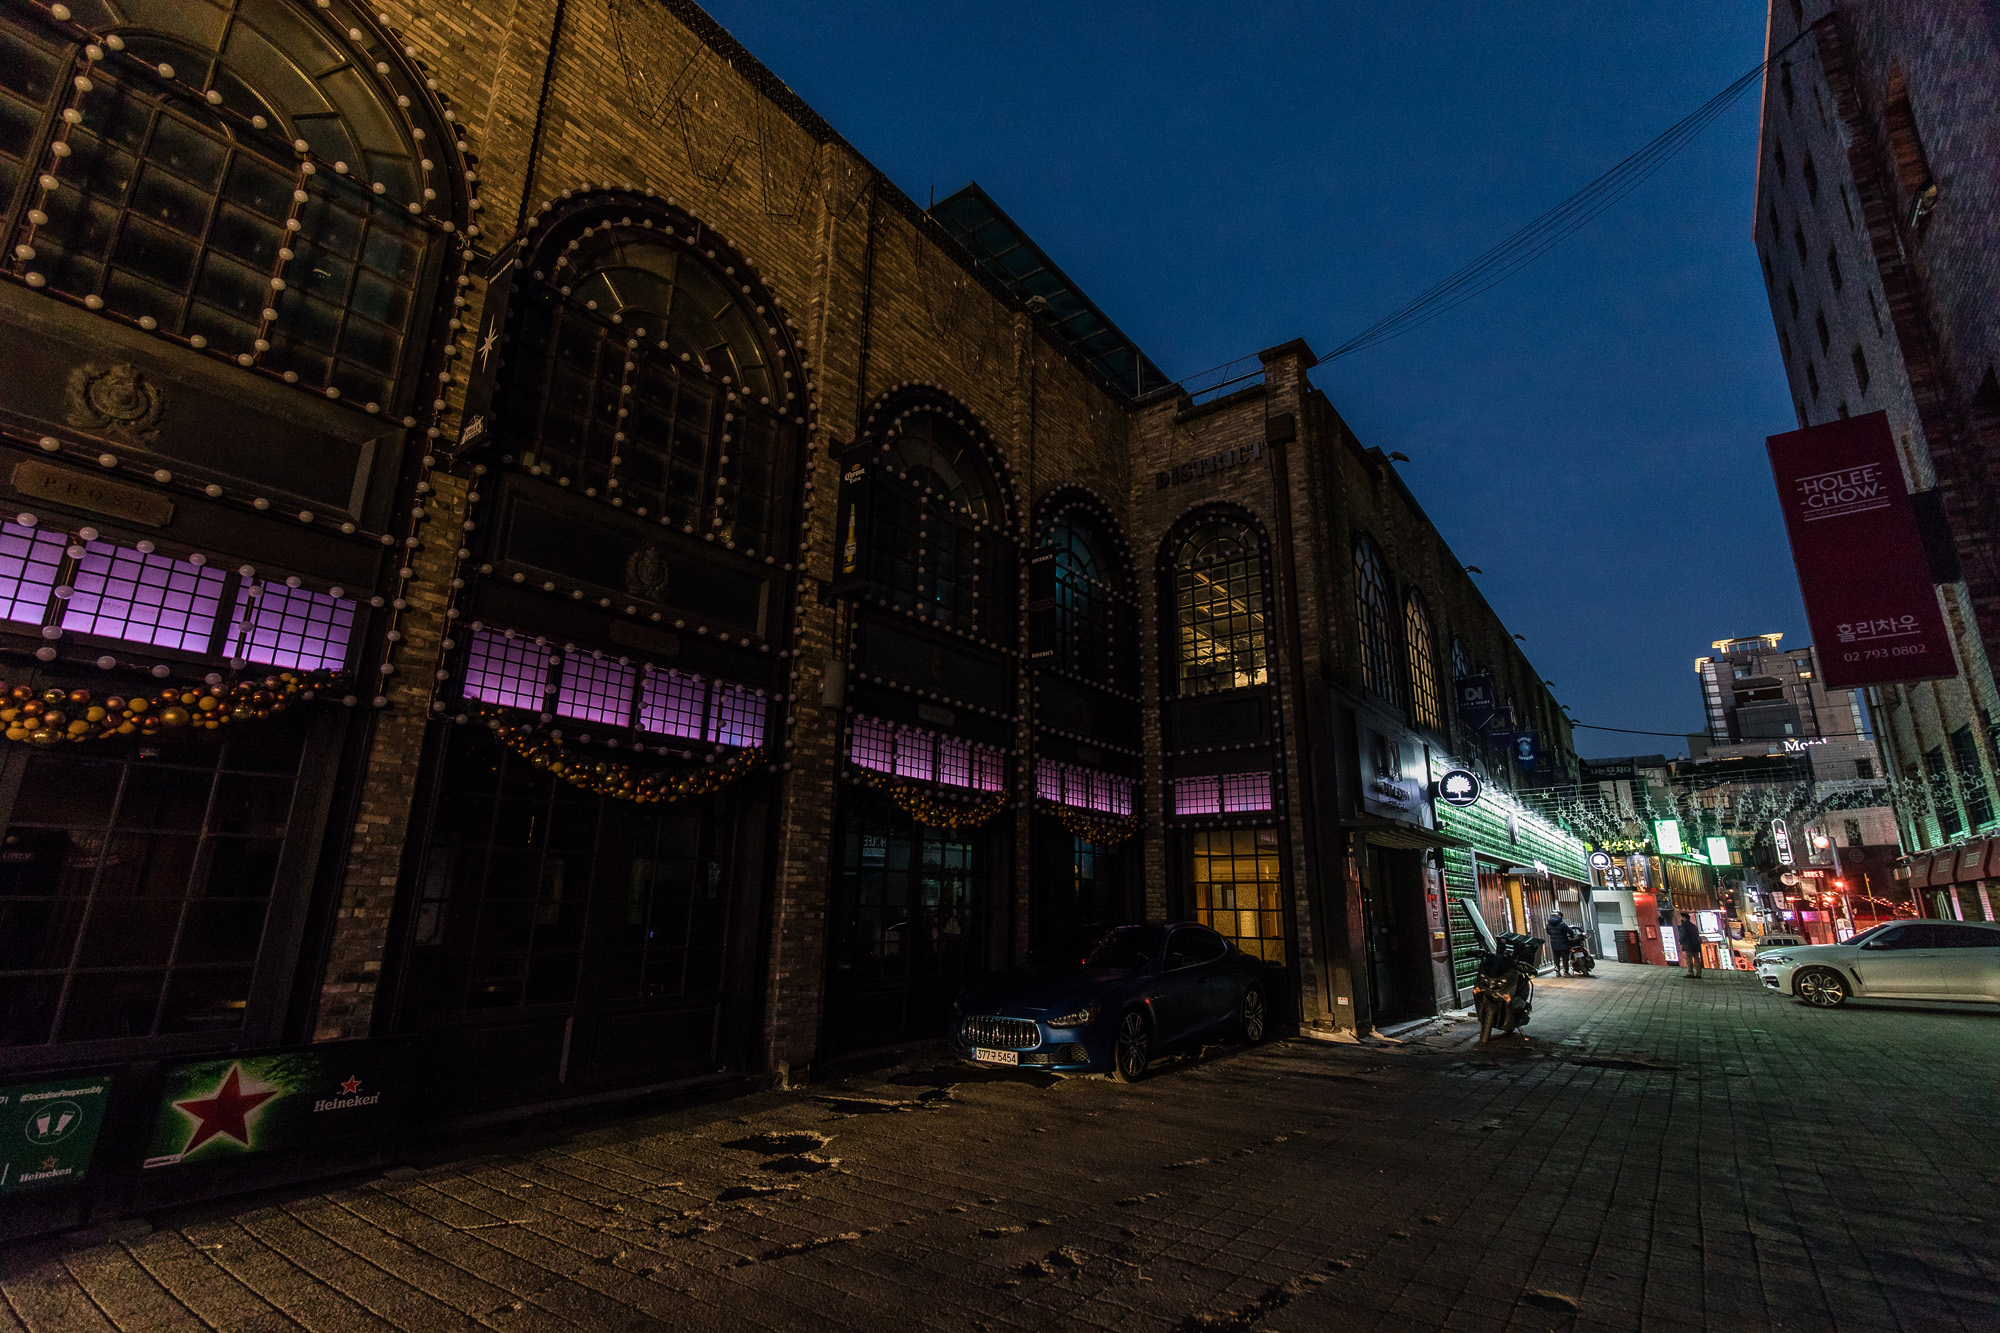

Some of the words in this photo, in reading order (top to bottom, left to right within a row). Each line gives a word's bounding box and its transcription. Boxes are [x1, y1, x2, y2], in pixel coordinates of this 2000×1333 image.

[1156, 441, 1265, 489] DISTRICT
[45, 477, 147, 511] PROST
[1032, 554, 1053, 564] DISTRICT
[1836, 615, 1919, 643] 홀리차우
[1032, 650, 1053, 659] DISTRICT
[1843, 652, 1861, 662] 02
[1864, 648, 1888, 660] 793
[1892, 644, 1927, 657] 0802
[997, 1051, 1016, 1063] 5454
[314, 1096, 379, 1112] Heineken
[19, 1167, 72, 1184] Heineken
